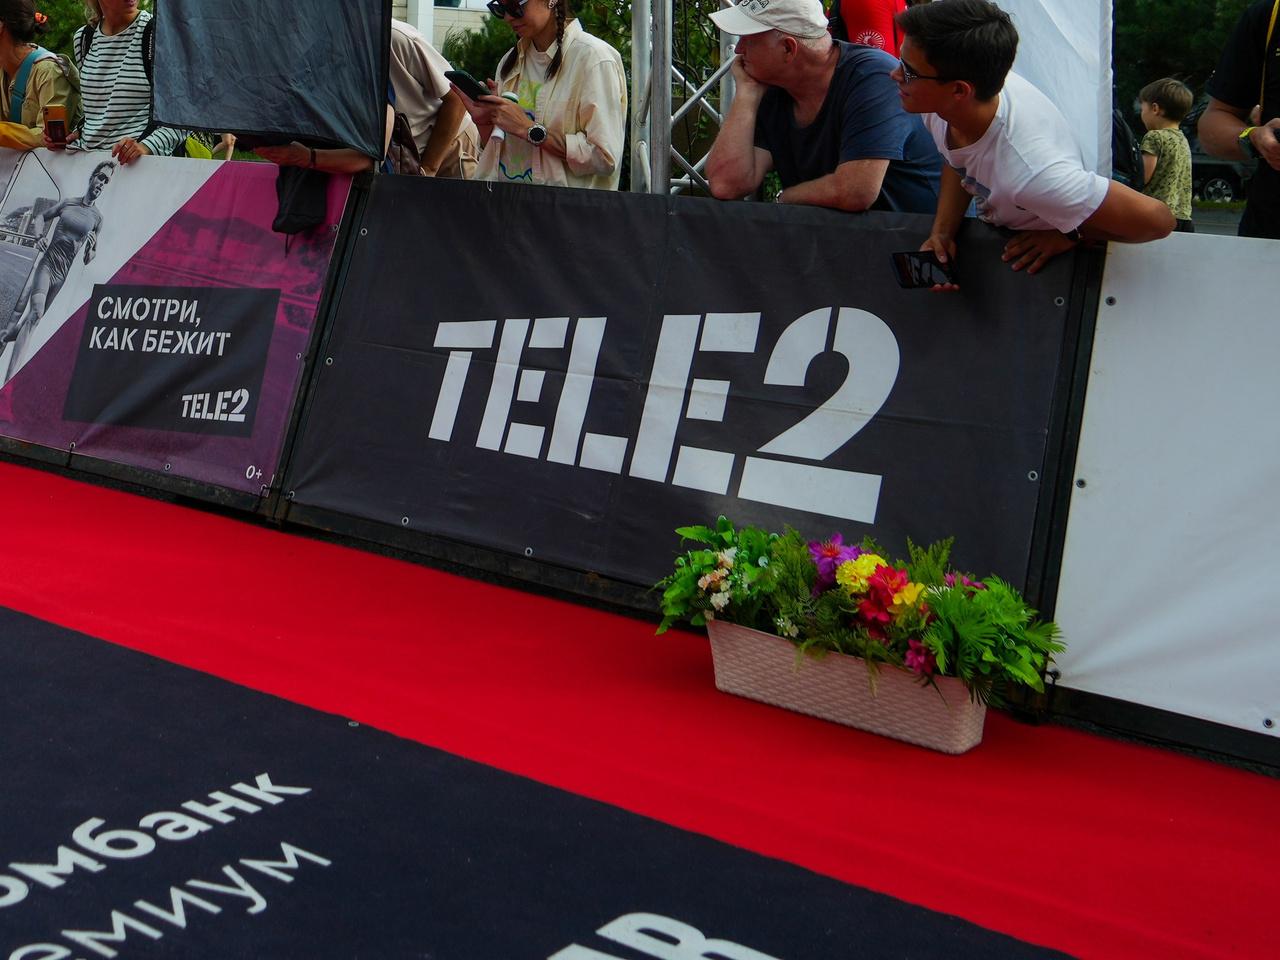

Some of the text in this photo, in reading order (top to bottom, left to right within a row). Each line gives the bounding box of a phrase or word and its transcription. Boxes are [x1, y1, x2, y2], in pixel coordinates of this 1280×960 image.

[97, 296, 201, 327] СМОТРИ,
[89, 326, 231, 356] КАК БЕЖИТ
[181, 388, 250, 422] TELE2
[429, 306, 900, 524] TELE2
